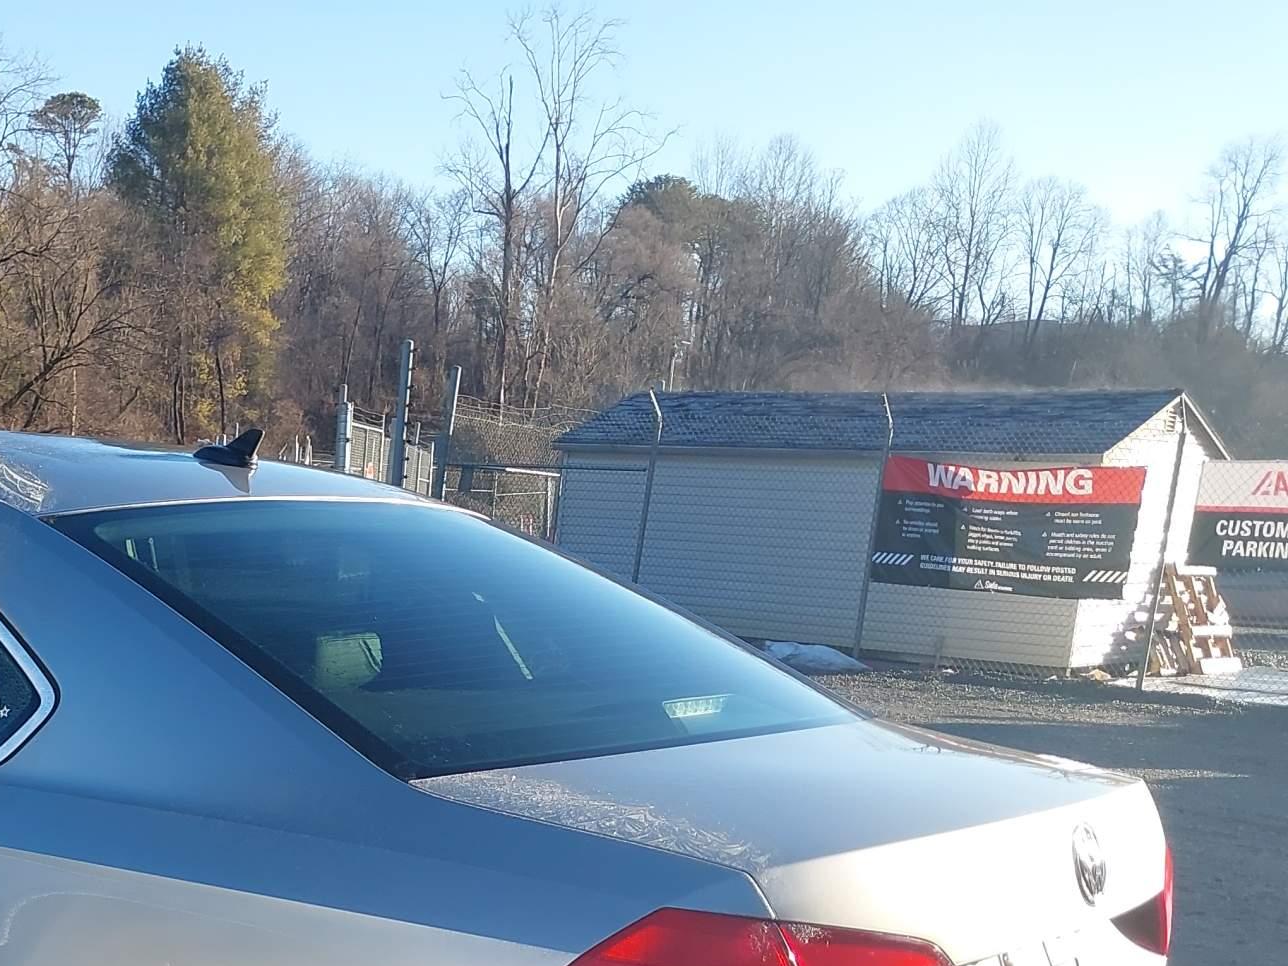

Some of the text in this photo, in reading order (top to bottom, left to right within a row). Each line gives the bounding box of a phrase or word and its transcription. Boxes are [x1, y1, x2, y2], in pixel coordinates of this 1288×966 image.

[927, 463, 1093, 496] WARNING
[1215, 519, 1288, 538] CUSTOM
[1221, 540, 1288, 559] PARKIN
[966, 566, 988, 574] RESULT
[996, 570, 1019, 578] SERIOUS
[1021, 572, 1042, 580] INJURY
[1027, 564, 1051, 573] FOLLOW
[1051, 566, 1076, 574] POSTED
